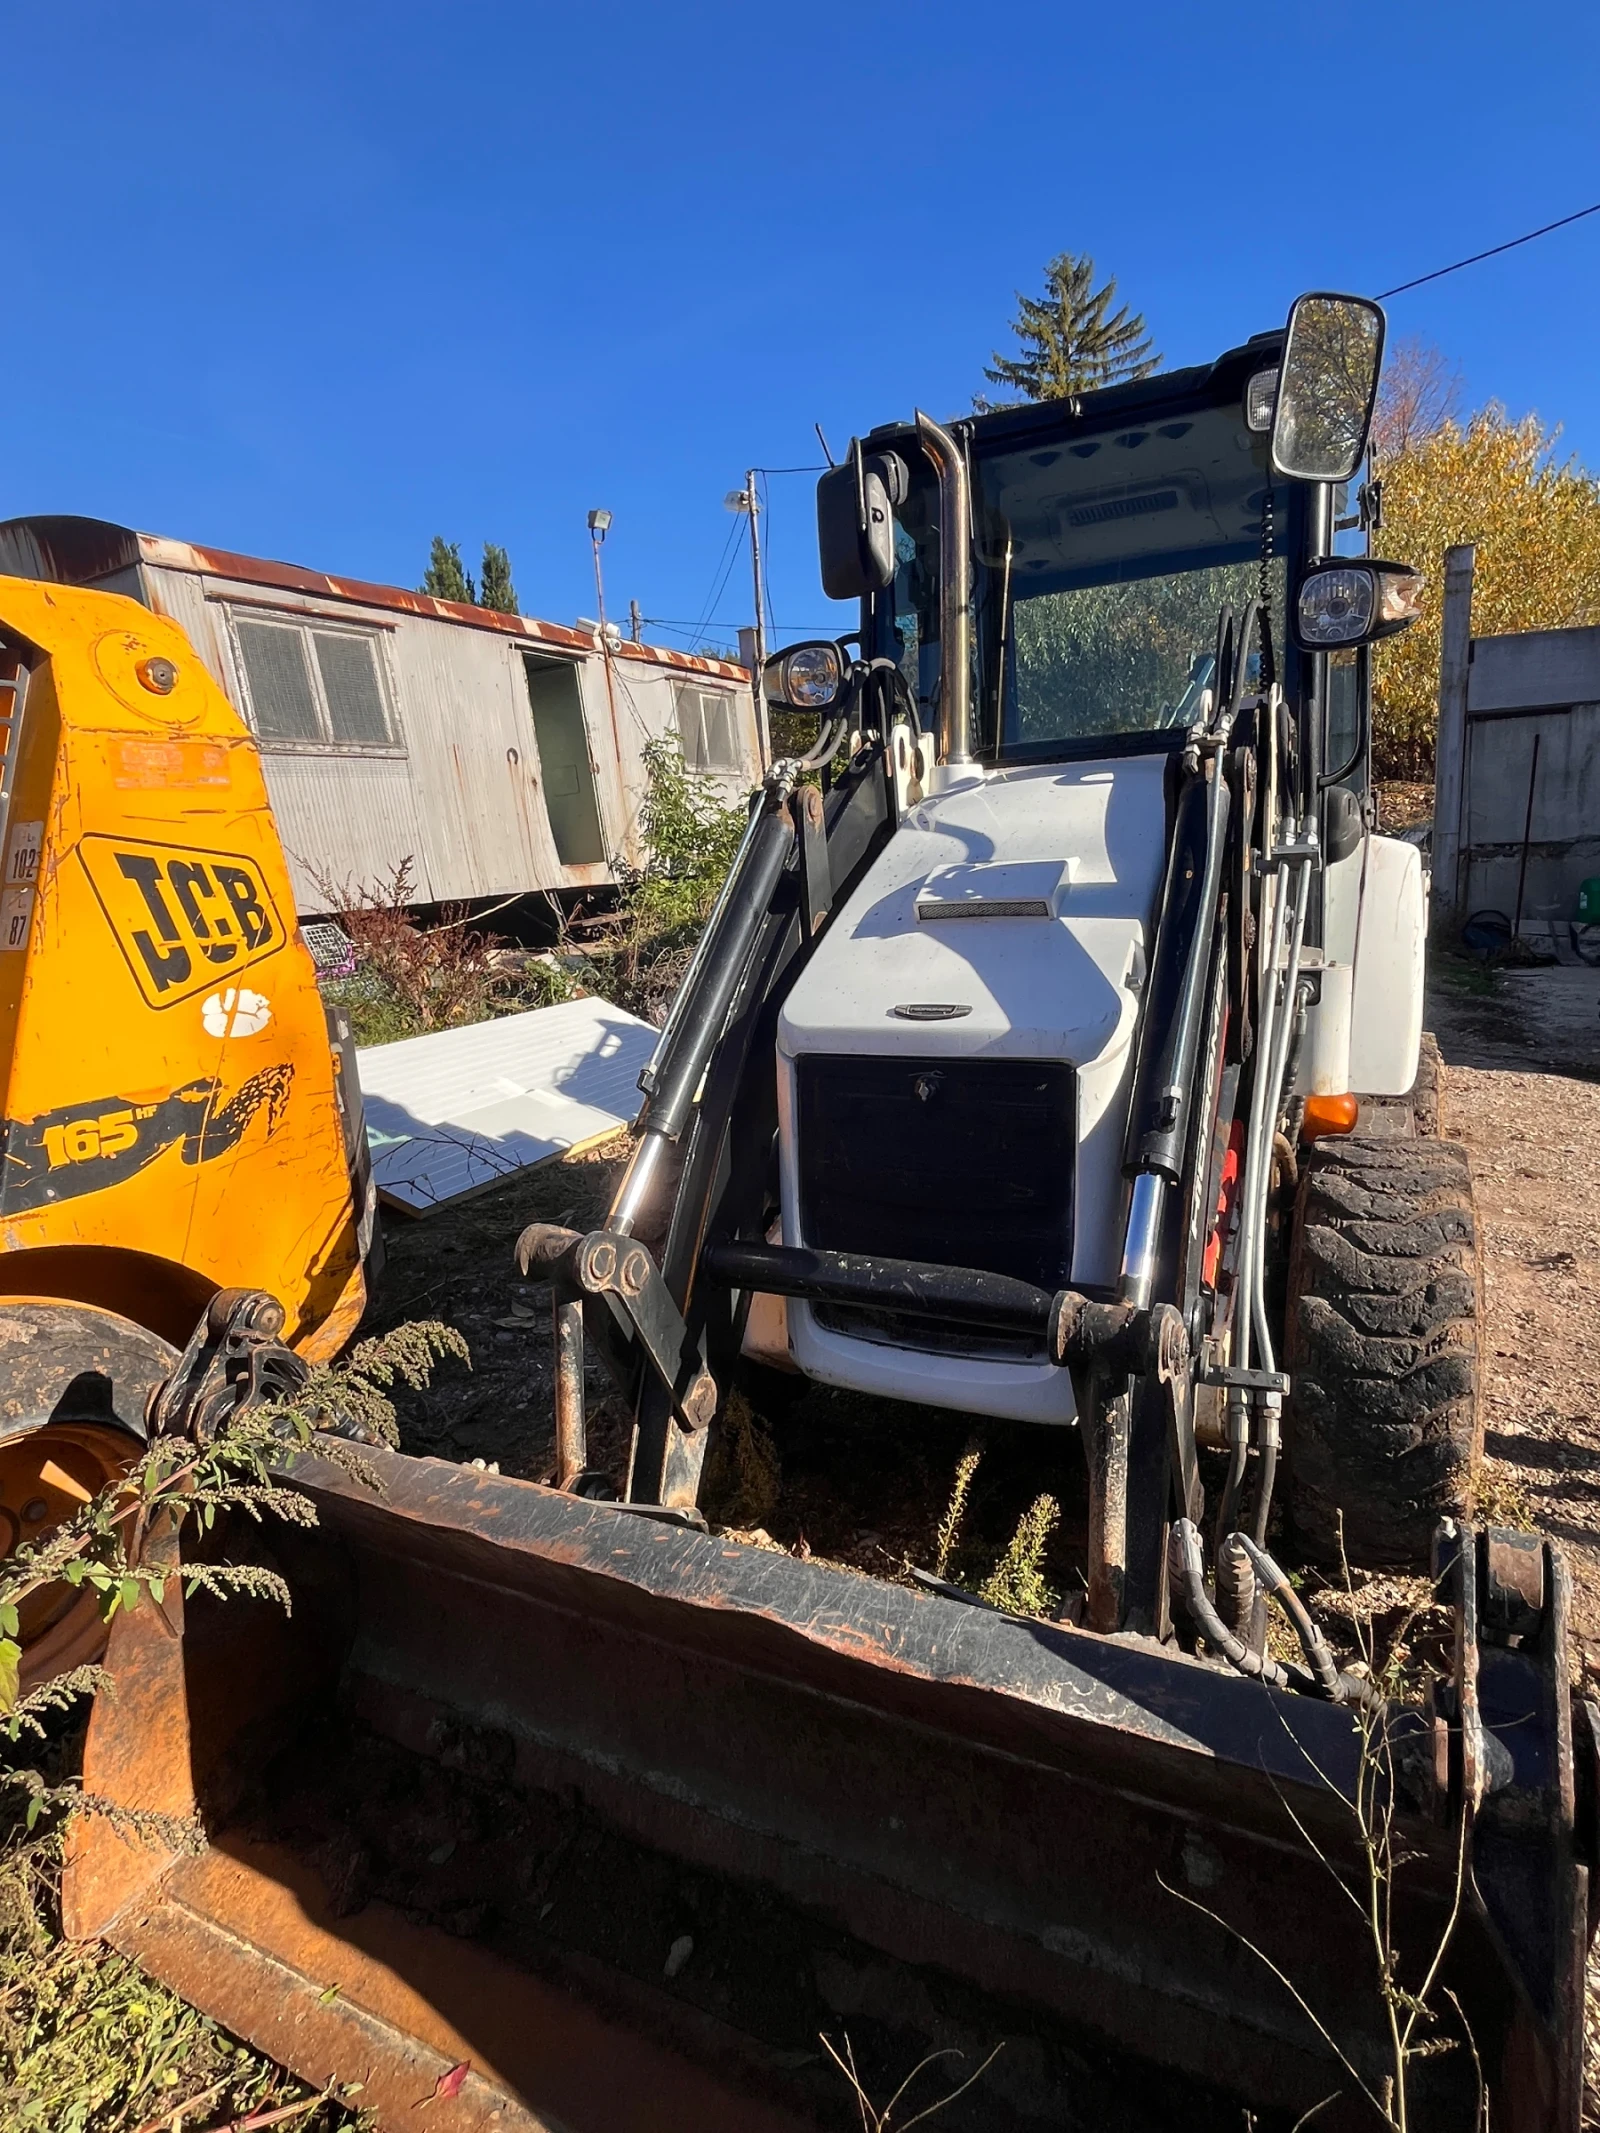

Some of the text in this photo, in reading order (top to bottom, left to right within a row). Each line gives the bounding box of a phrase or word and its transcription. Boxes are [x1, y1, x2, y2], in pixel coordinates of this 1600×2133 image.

[12, 848, 37, 879] 102
[8, 915, 27, 946] 87
[113, 852, 273, 993] JCB
[42, 1104, 158, 1169] 165 HF
